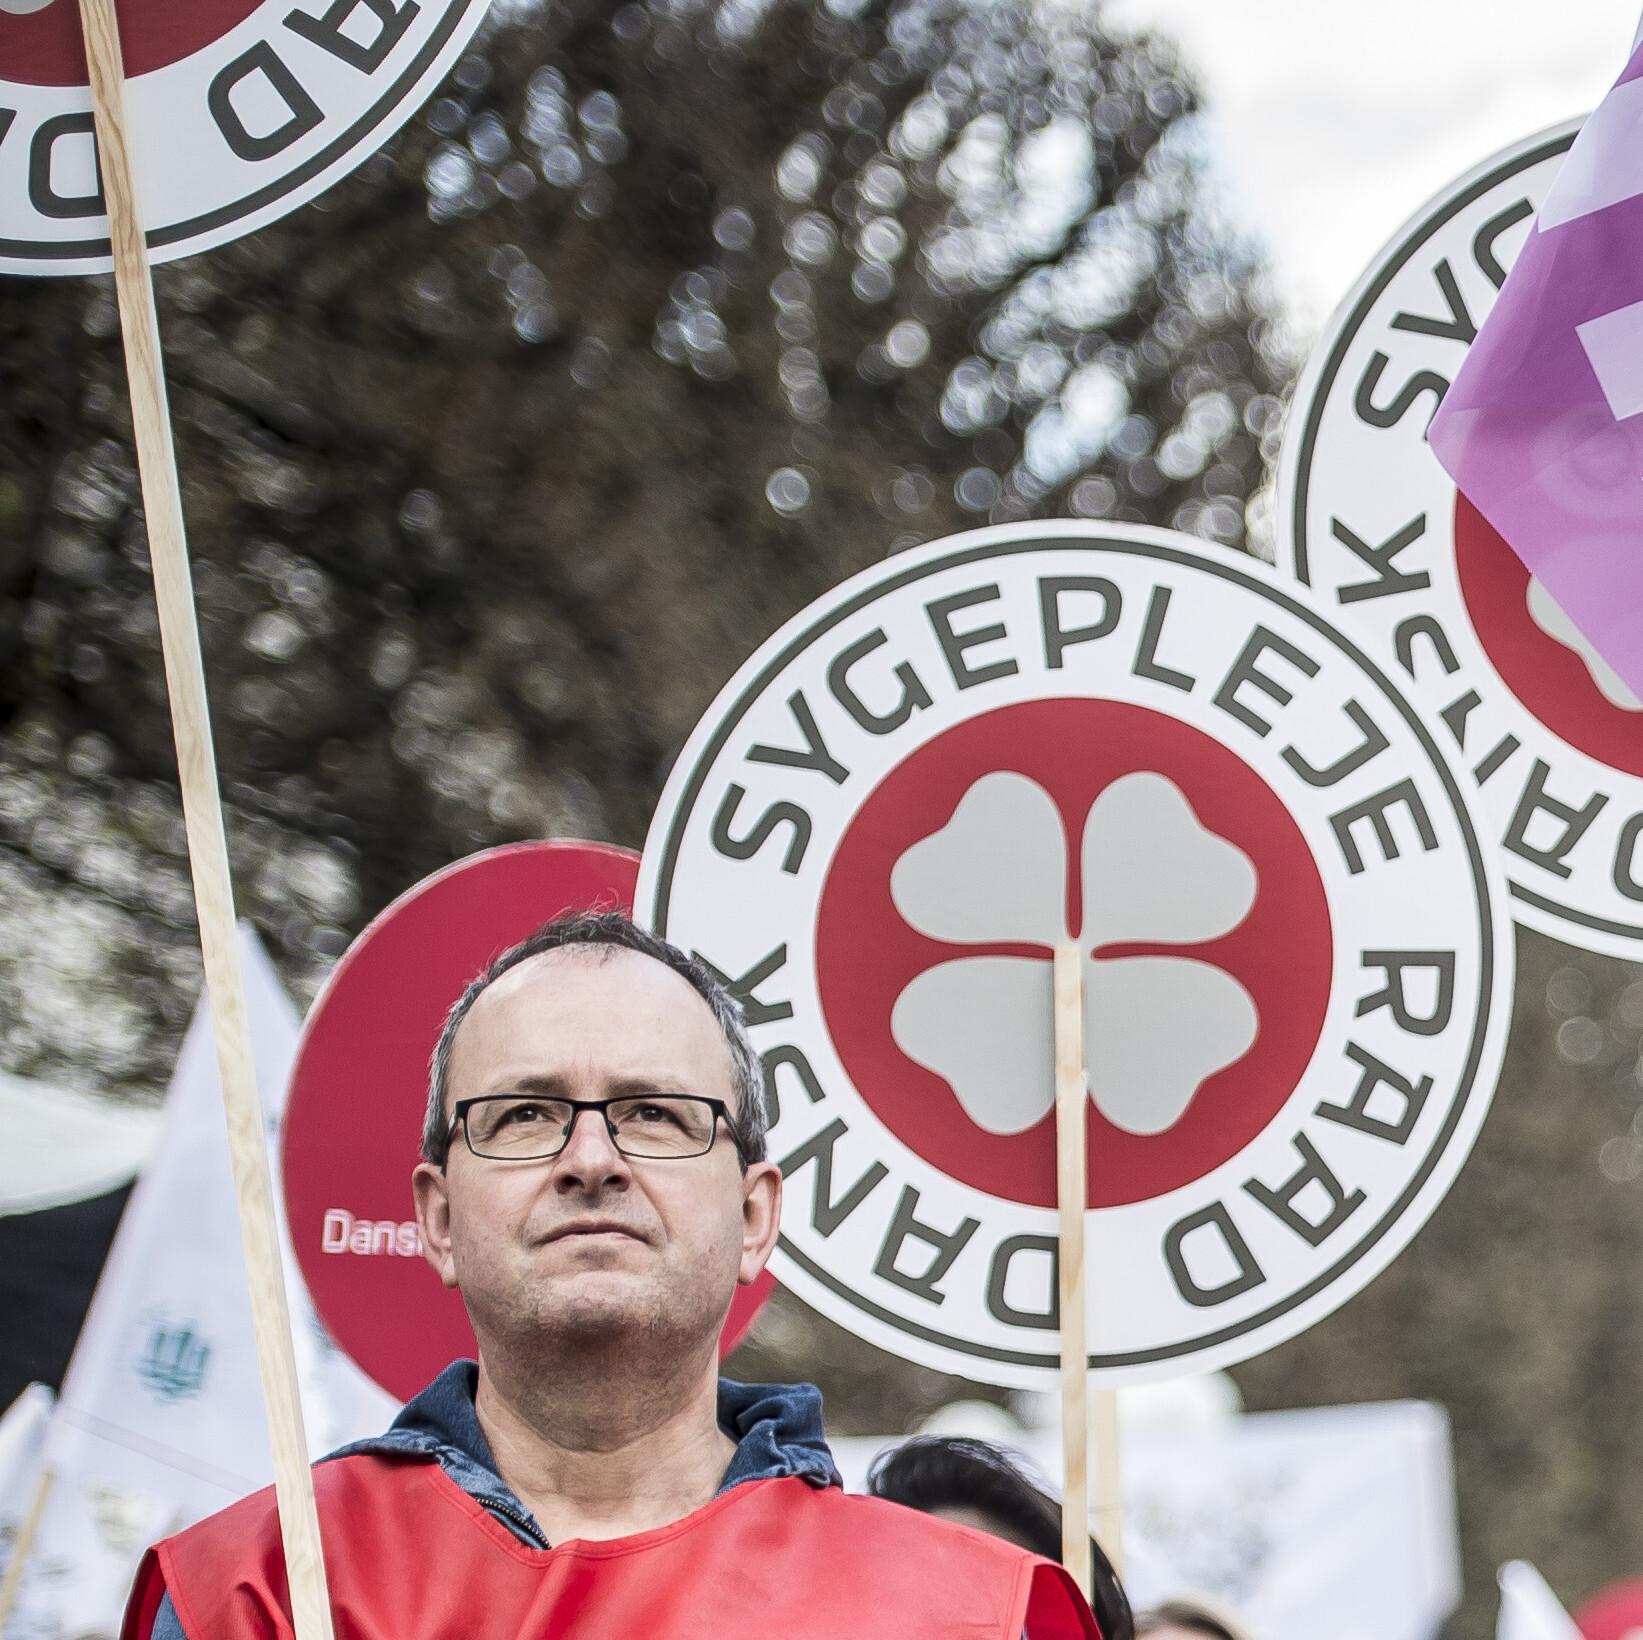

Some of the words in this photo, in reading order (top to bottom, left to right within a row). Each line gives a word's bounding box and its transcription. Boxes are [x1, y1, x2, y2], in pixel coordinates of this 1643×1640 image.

[710, 575, 1440, 875] SYGEPLEJE
[1163, 950, 1456, 1308] RAAD
[320, 1207, 423, 1257] Dans
